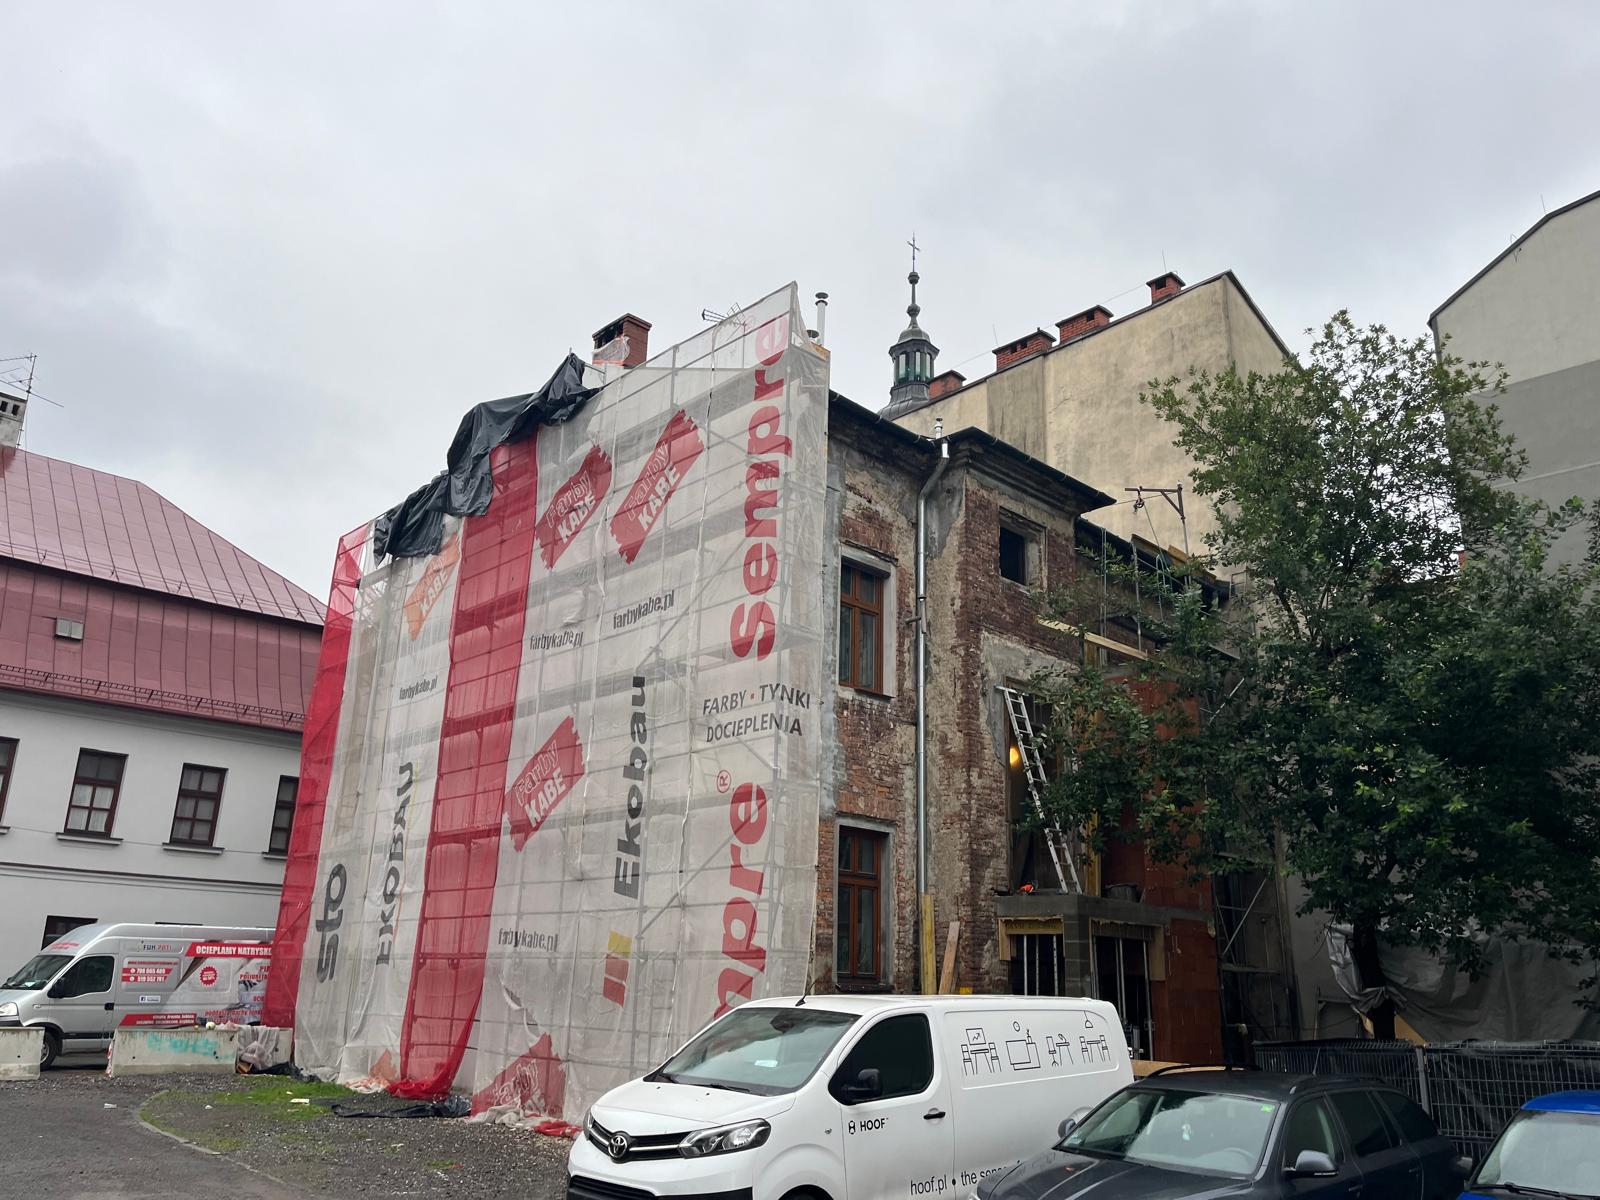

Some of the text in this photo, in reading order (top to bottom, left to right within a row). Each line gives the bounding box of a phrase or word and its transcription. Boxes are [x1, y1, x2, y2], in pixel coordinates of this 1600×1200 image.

[545, 469, 592, 528] Farby
[624, 441, 670, 521] Farby
[637, 462, 681, 531] KABE
[557, 492, 596, 544] KABE
[420, 569, 448, 618] KABE
[613, 590, 675, 630] farbykabe.pl
[530, 630, 584, 651] farbykabe.pl
[703, 683, 811, 716] FARBY TYNKI
[706, 713, 803, 743] DOCIEPLENIA
[514, 739, 559, 806] Farby
[613, 676, 648, 900] Ekobau
[524, 767, 566, 828] KABE
[315, 863, 347, 983] sto
[498, 928, 559, 952] farbykabe.pl
[195, 945, 237, 955] OCIEPLAMY
[860, 1118, 886, 1132] HOOF
[910, 1174, 948, 1196] hoof.pl
[960, 1171, 978, 1187] the
